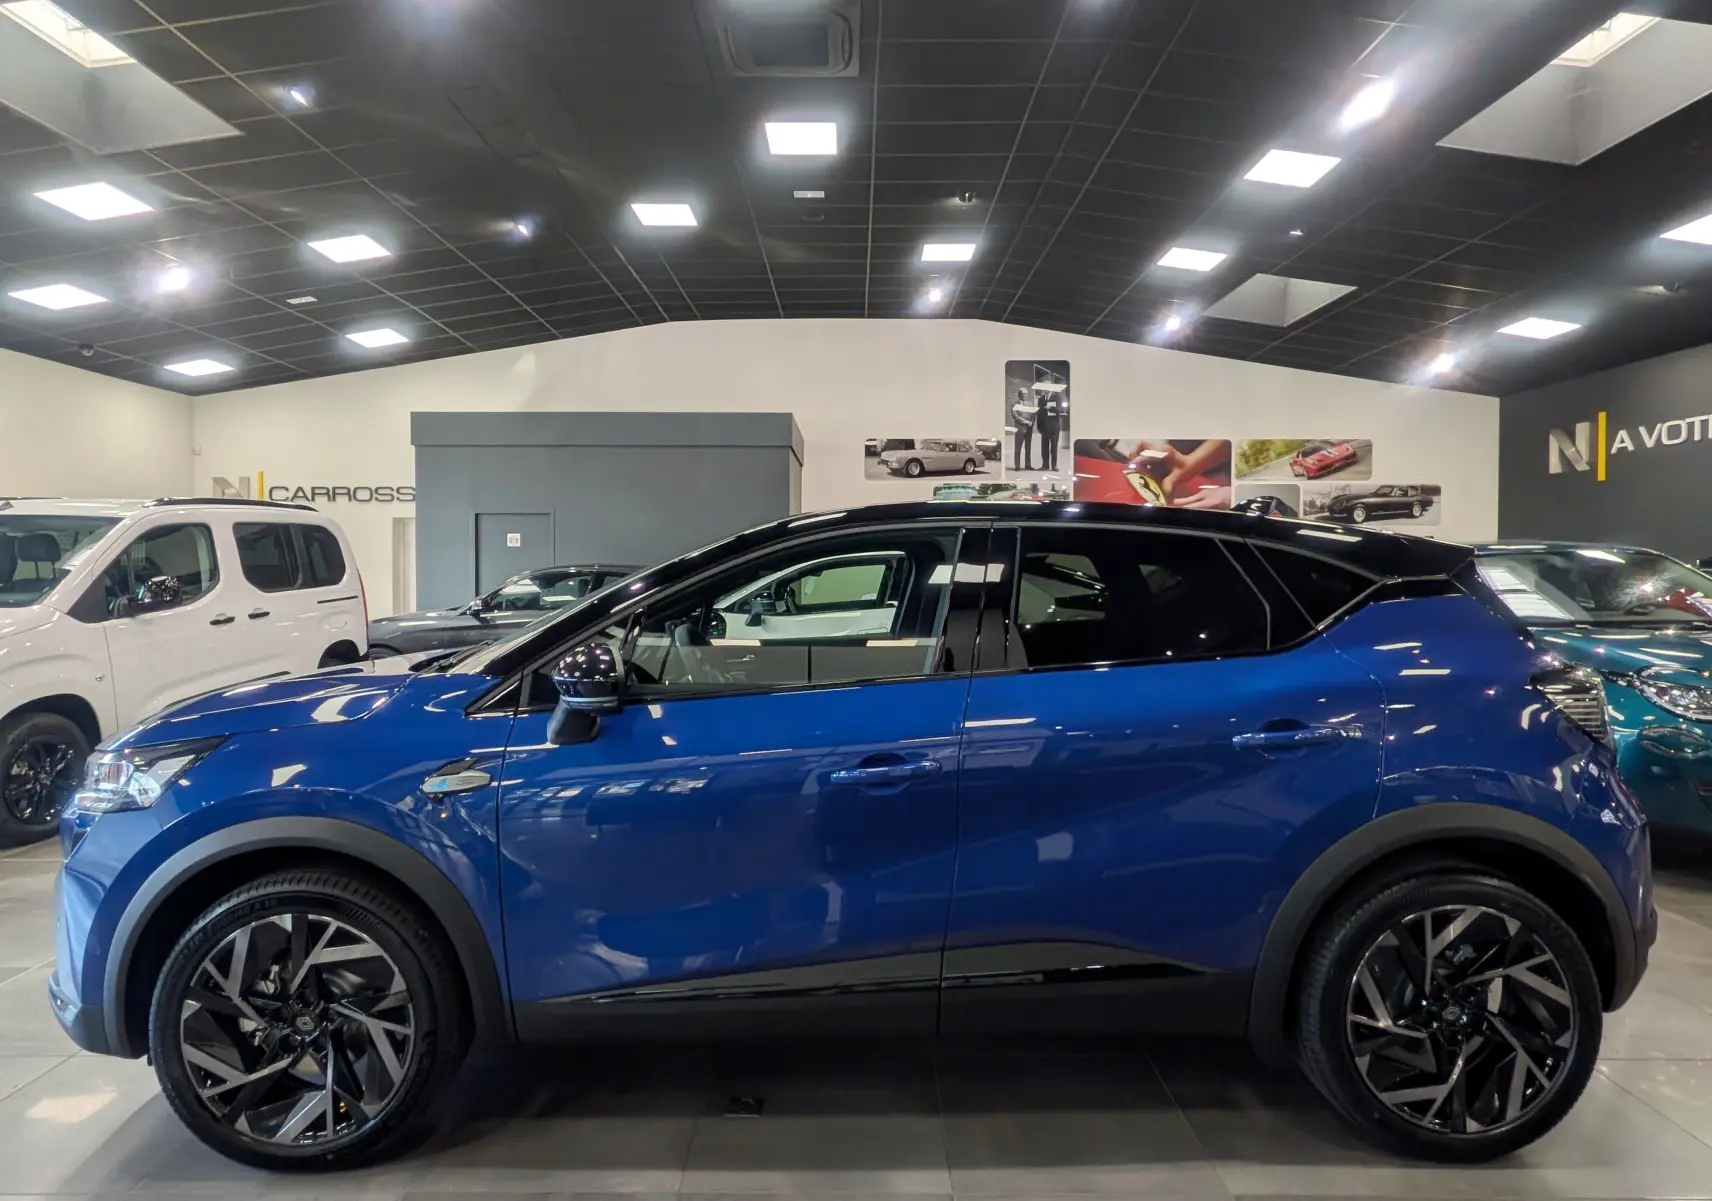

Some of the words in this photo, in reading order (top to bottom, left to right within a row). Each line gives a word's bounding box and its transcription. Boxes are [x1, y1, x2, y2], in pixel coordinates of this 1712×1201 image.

[1611, 430, 1635, 454] A
[1639, 415, 1712, 448] VOT
[268, 486, 416, 503] CARROSS
